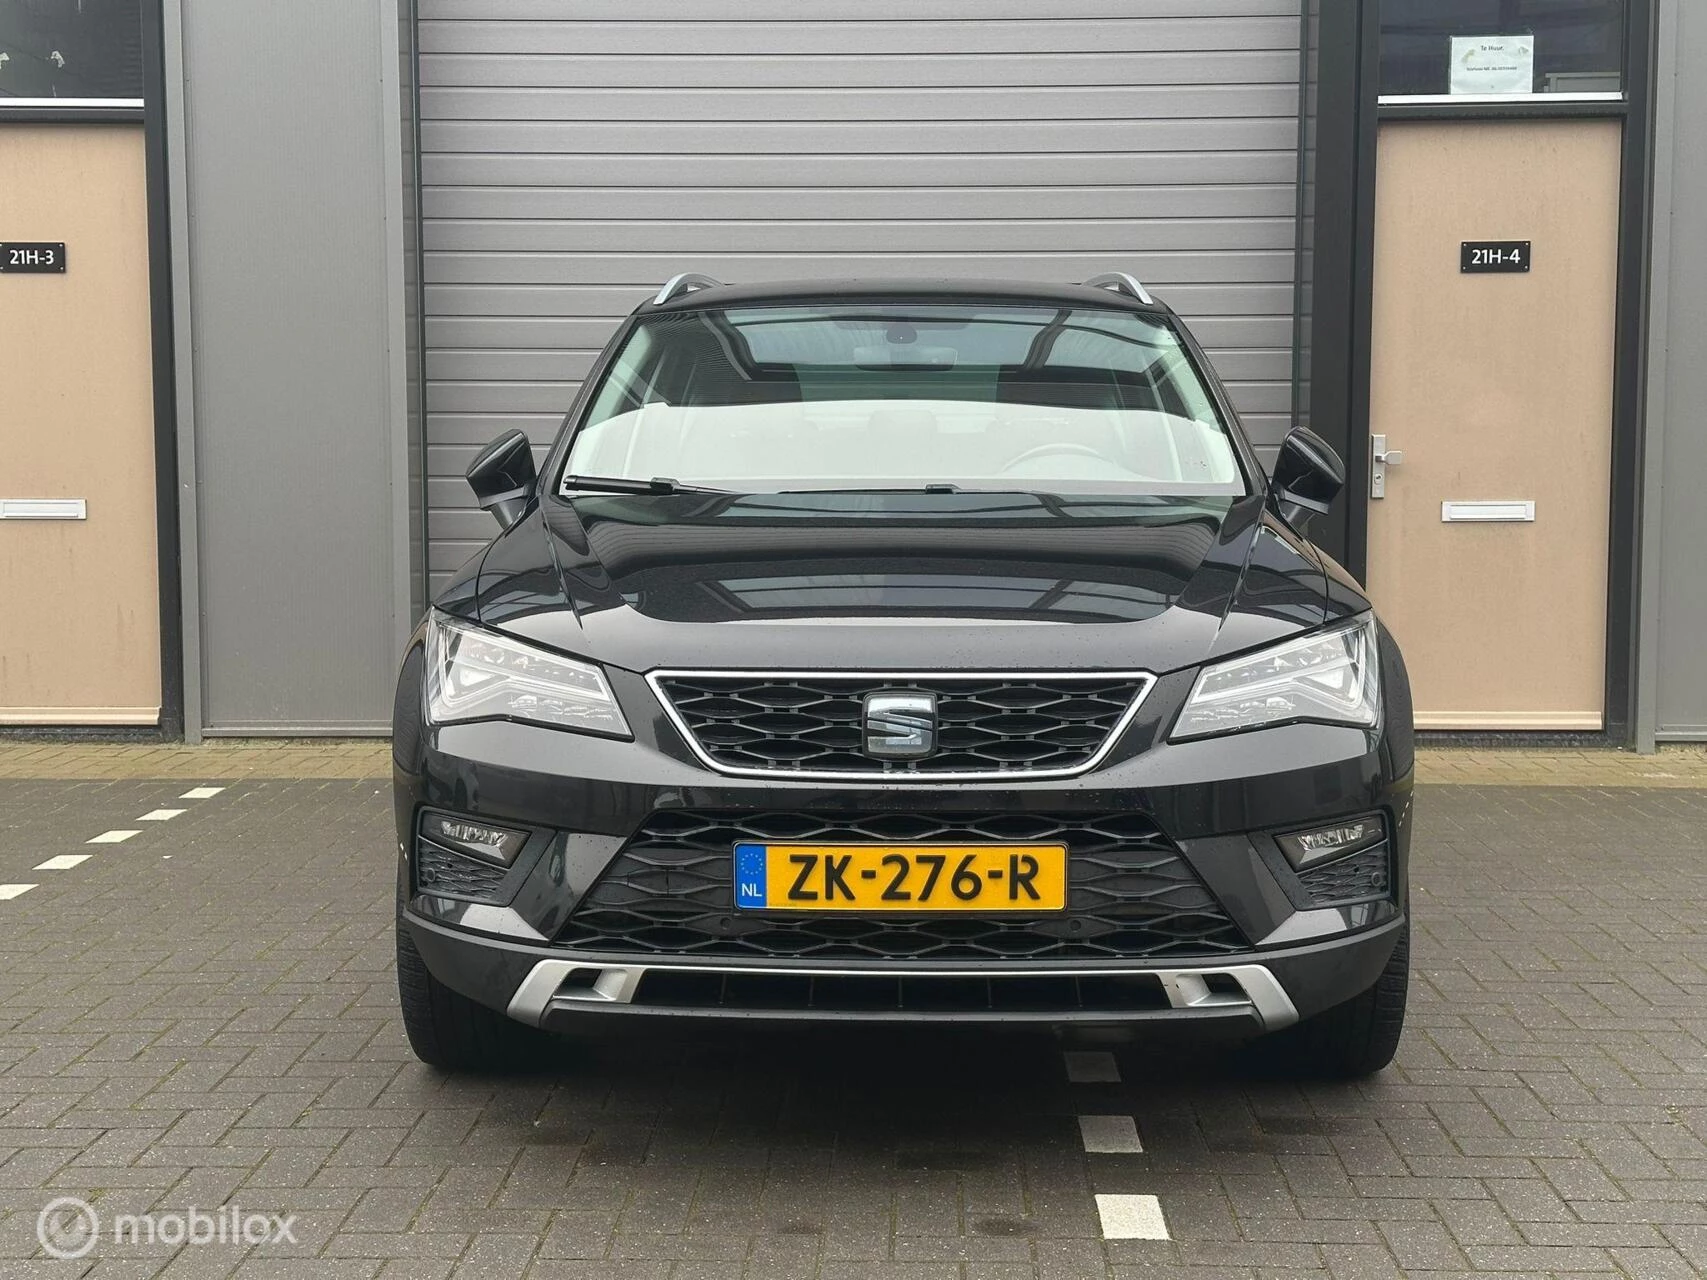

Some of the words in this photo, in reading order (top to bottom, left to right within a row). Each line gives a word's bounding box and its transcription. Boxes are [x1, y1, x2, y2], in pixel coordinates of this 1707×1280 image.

[10, 249, 54, 265] 21H-3
[1472, 249, 1521, 264] 21H-4
[788, 854, 1041, 902] ZK-276-R
[741, 883, 762, 897] NL
